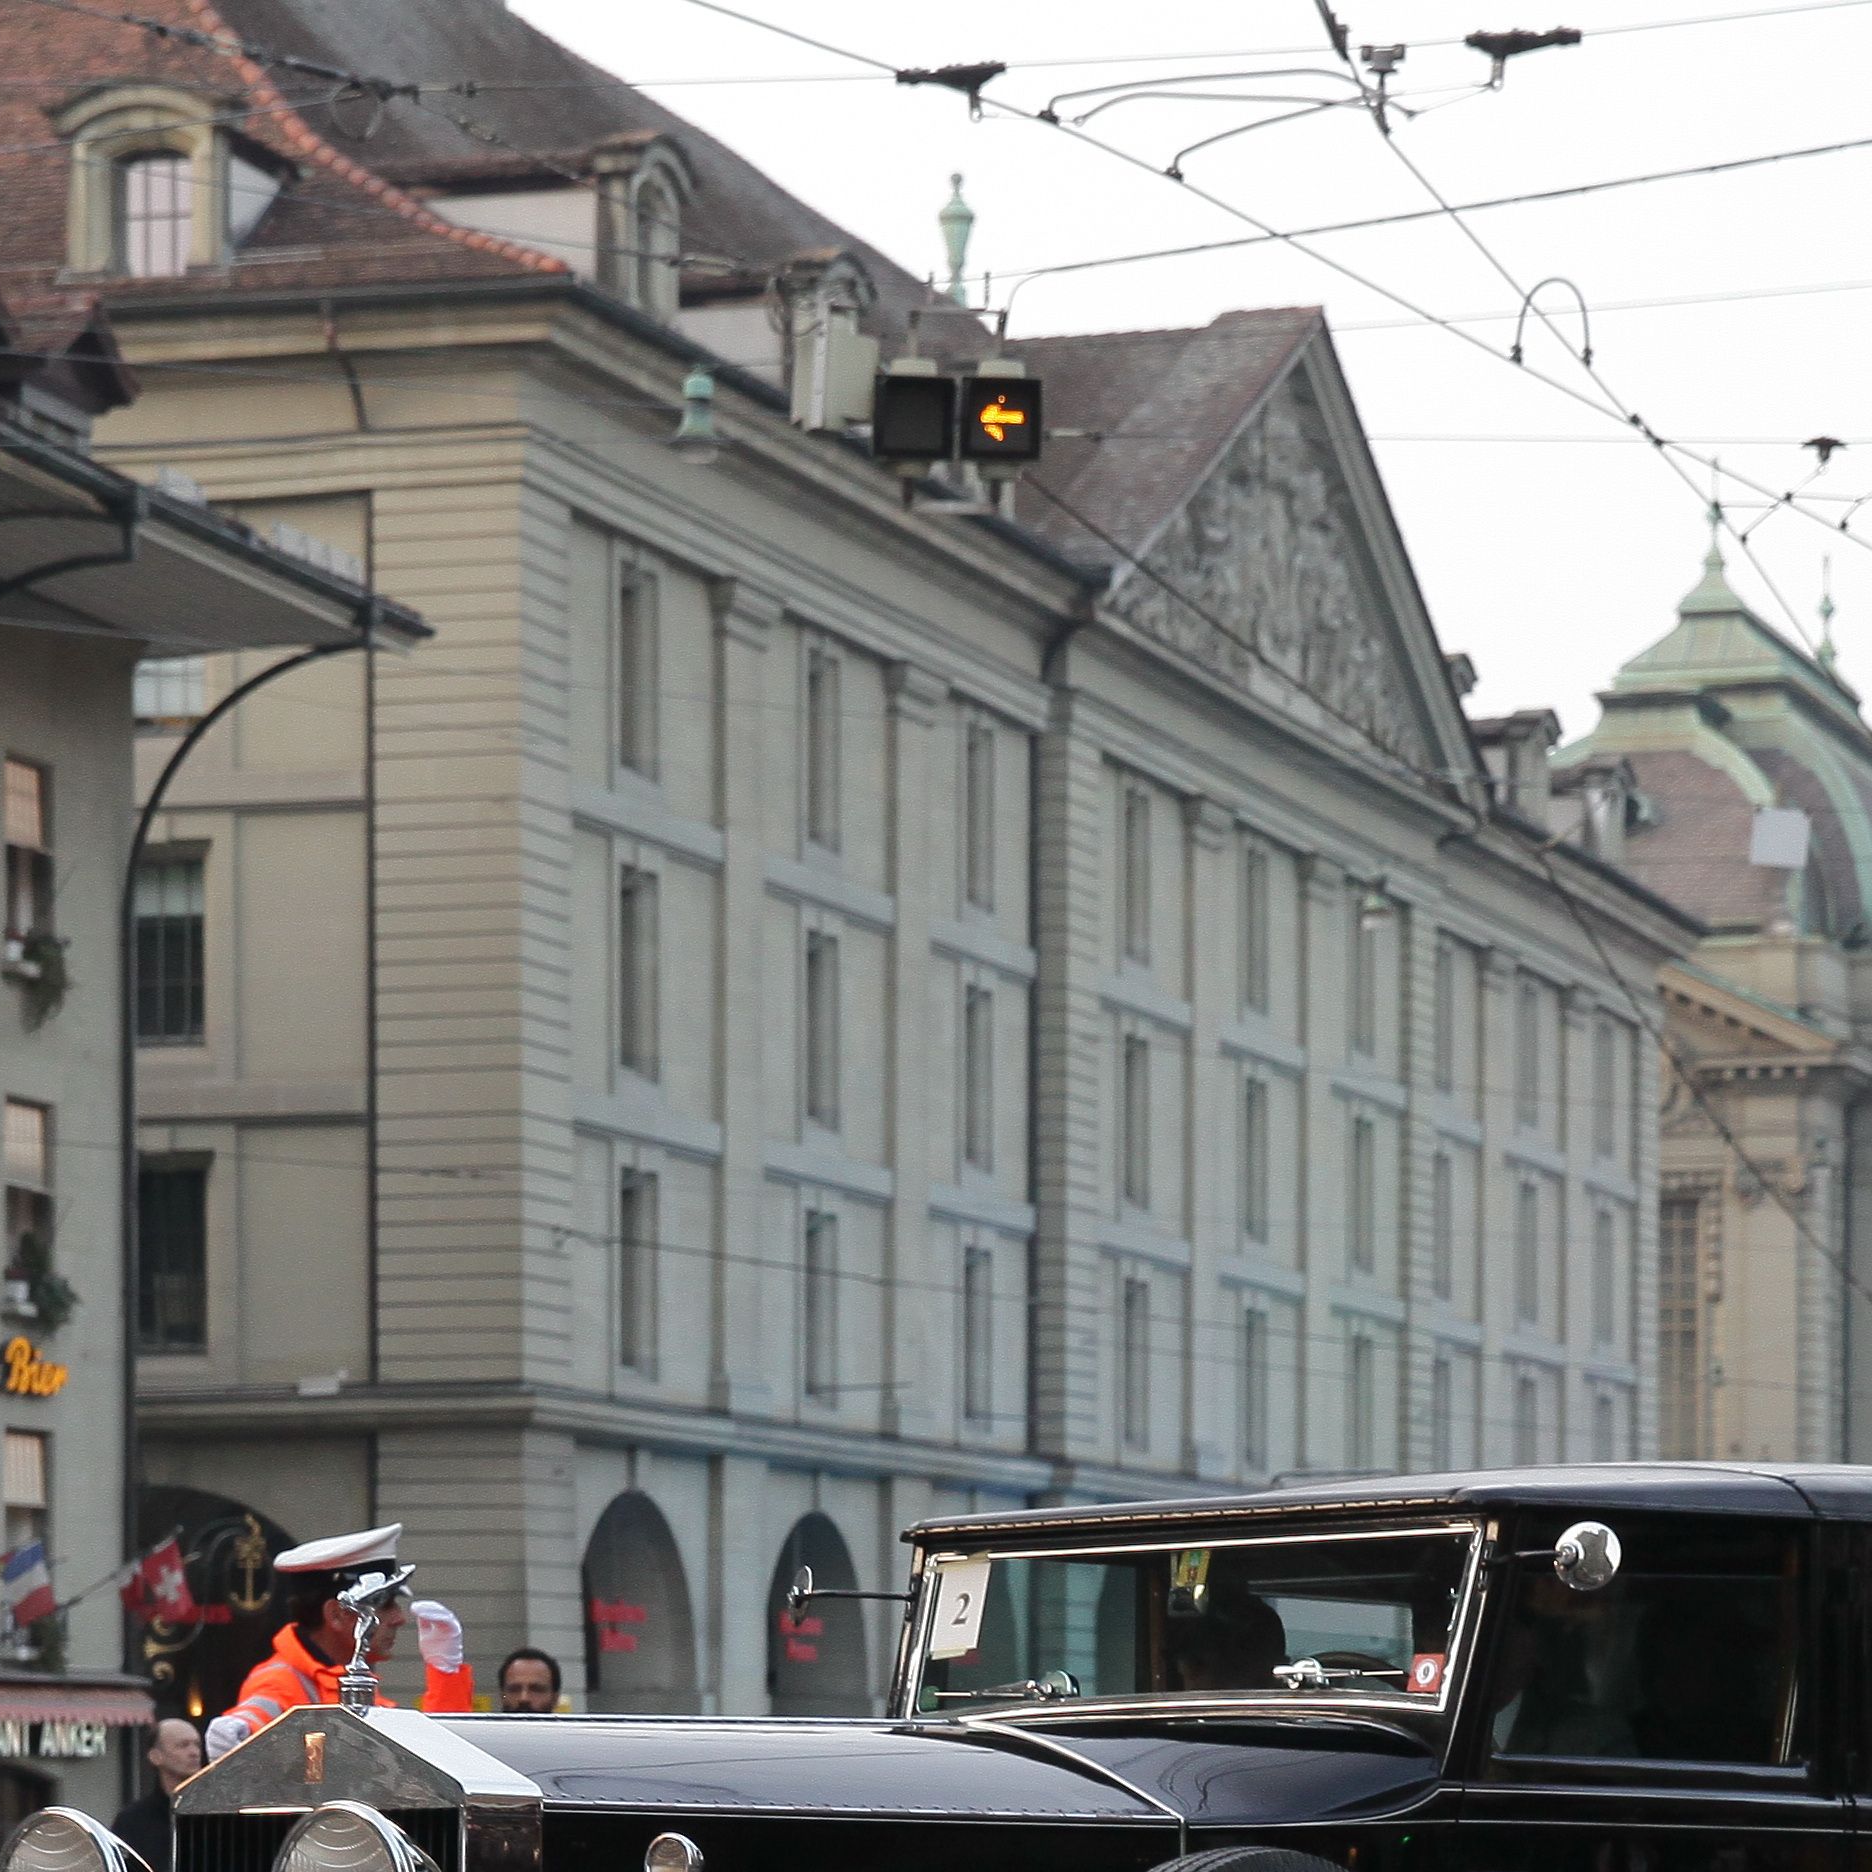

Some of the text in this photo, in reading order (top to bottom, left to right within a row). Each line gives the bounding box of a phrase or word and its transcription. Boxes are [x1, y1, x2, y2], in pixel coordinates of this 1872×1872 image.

[4, 1336, 69, 1397] Bier
[951, 1592, 971, 1626] 2
[39, 1718, 107, 1758] ANKER
